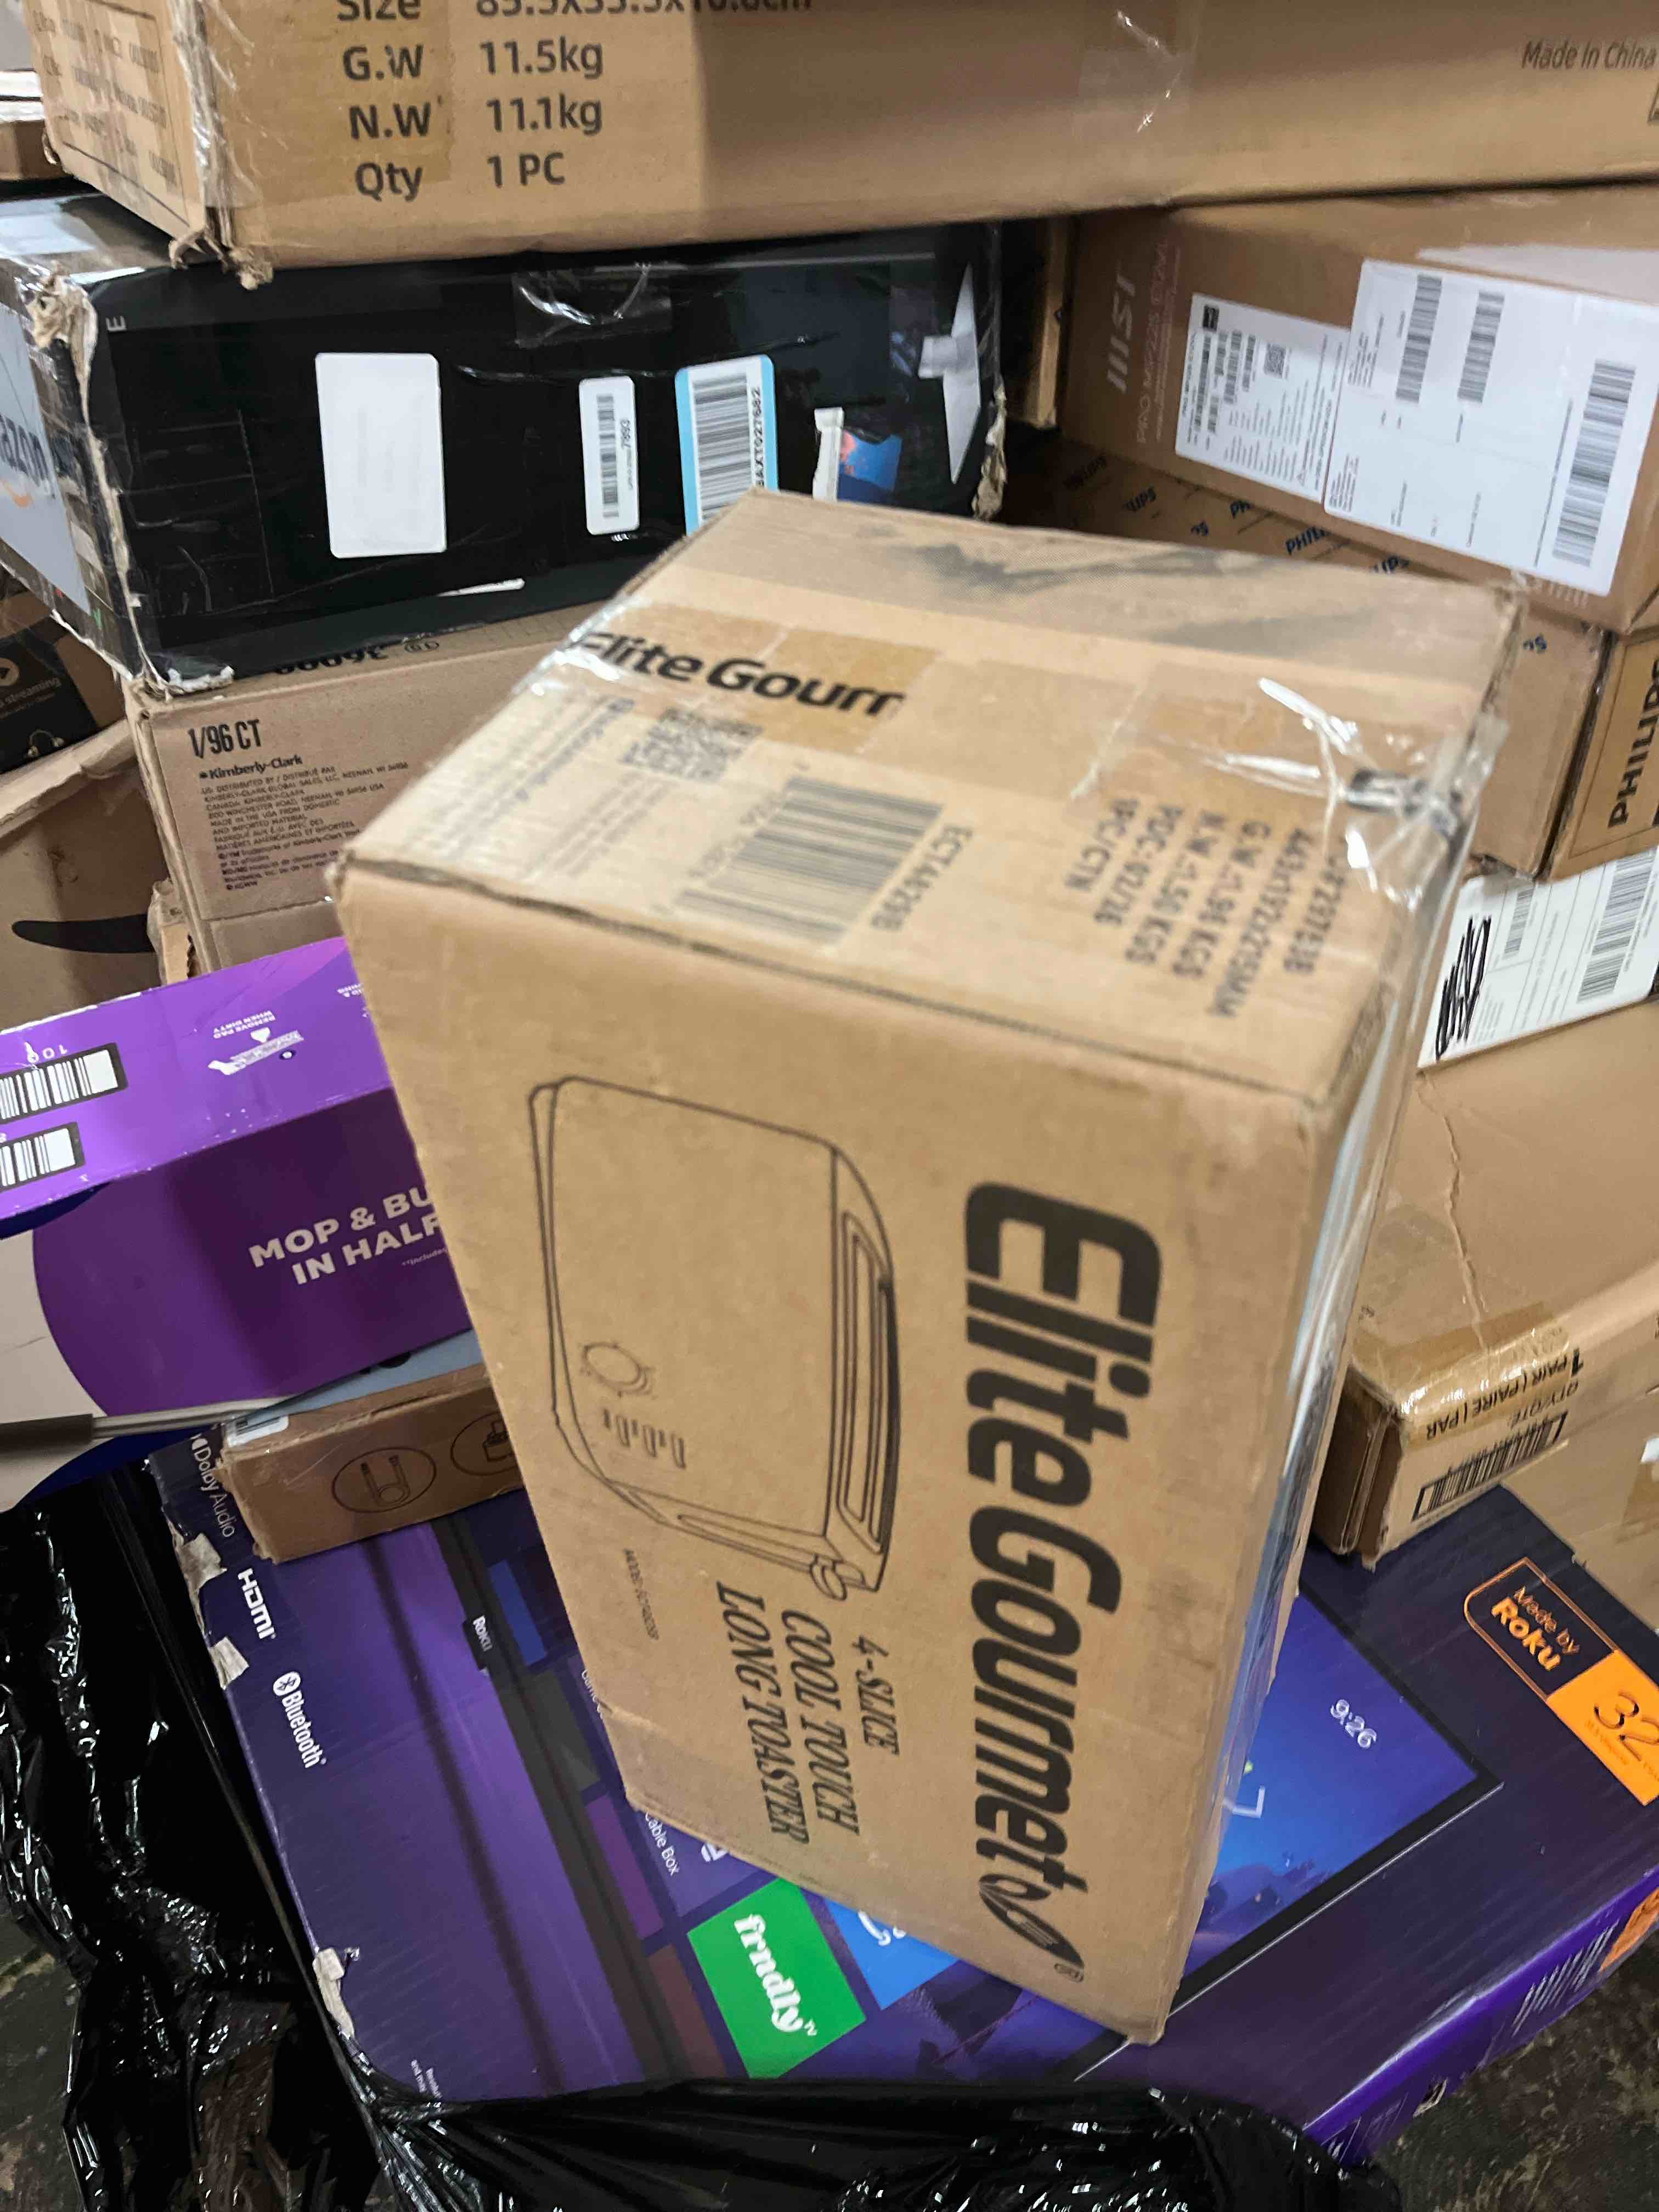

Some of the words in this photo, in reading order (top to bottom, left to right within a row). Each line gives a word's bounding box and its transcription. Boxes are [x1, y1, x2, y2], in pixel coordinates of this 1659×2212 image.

[343, 45, 424, 81] G.W
[479, 38, 604, 80] 11.5kg
[1521, 38, 1578, 70] Made
[1604, 38, 1658, 70] China
[349, 103, 431, 139] N.W
[486, 93, 603, 135] 11.1kg
[356, 162, 423, 201] Qty
[487, 155, 503, 187] 1
[520, 152, 566, 187] PC
[236, 719, 262, 748] CT
[210, 754, 303, 780] Kimberly-Clark
[216, 778, 262, 792] DISTRIBUTED
[268, 782, 296, 792] GLOBAL
[279, 806, 300, 815] FROM
[249, 1218, 340, 1268] MOP
[349, 1206, 376, 1231] &
[292, 1252, 336, 1284] IN
[342, 1211, 439, 1266] HALF
[1426, 1406, 1459, 1441] PAR
[1472, 1378, 1519, 1418] PAIRE
[194, 1446, 219, 1492] Dolby
[210, 1493, 238, 1538] Audio
[238, 1567, 274, 1640] HDMI
[1514, 1586, 1558, 1633] Made
[1556, 1628, 1581, 1655] by
[716, 1580, 782, 1698] LONG
[781, 1609, 842, 1711] COOL
[851, 1634, 900, 1756] 4-SLICE
[281, 1690, 325, 1769] Bluetooth
[1329, 1698, 1378, 1749] 9:26
[742, 1695, 810, 1844] TOASTER
[799, 1713, 860, 1836] TOUCH
[662, 1846, 680, 1876] Box
[733, 1912, 805, 2033] frndly
